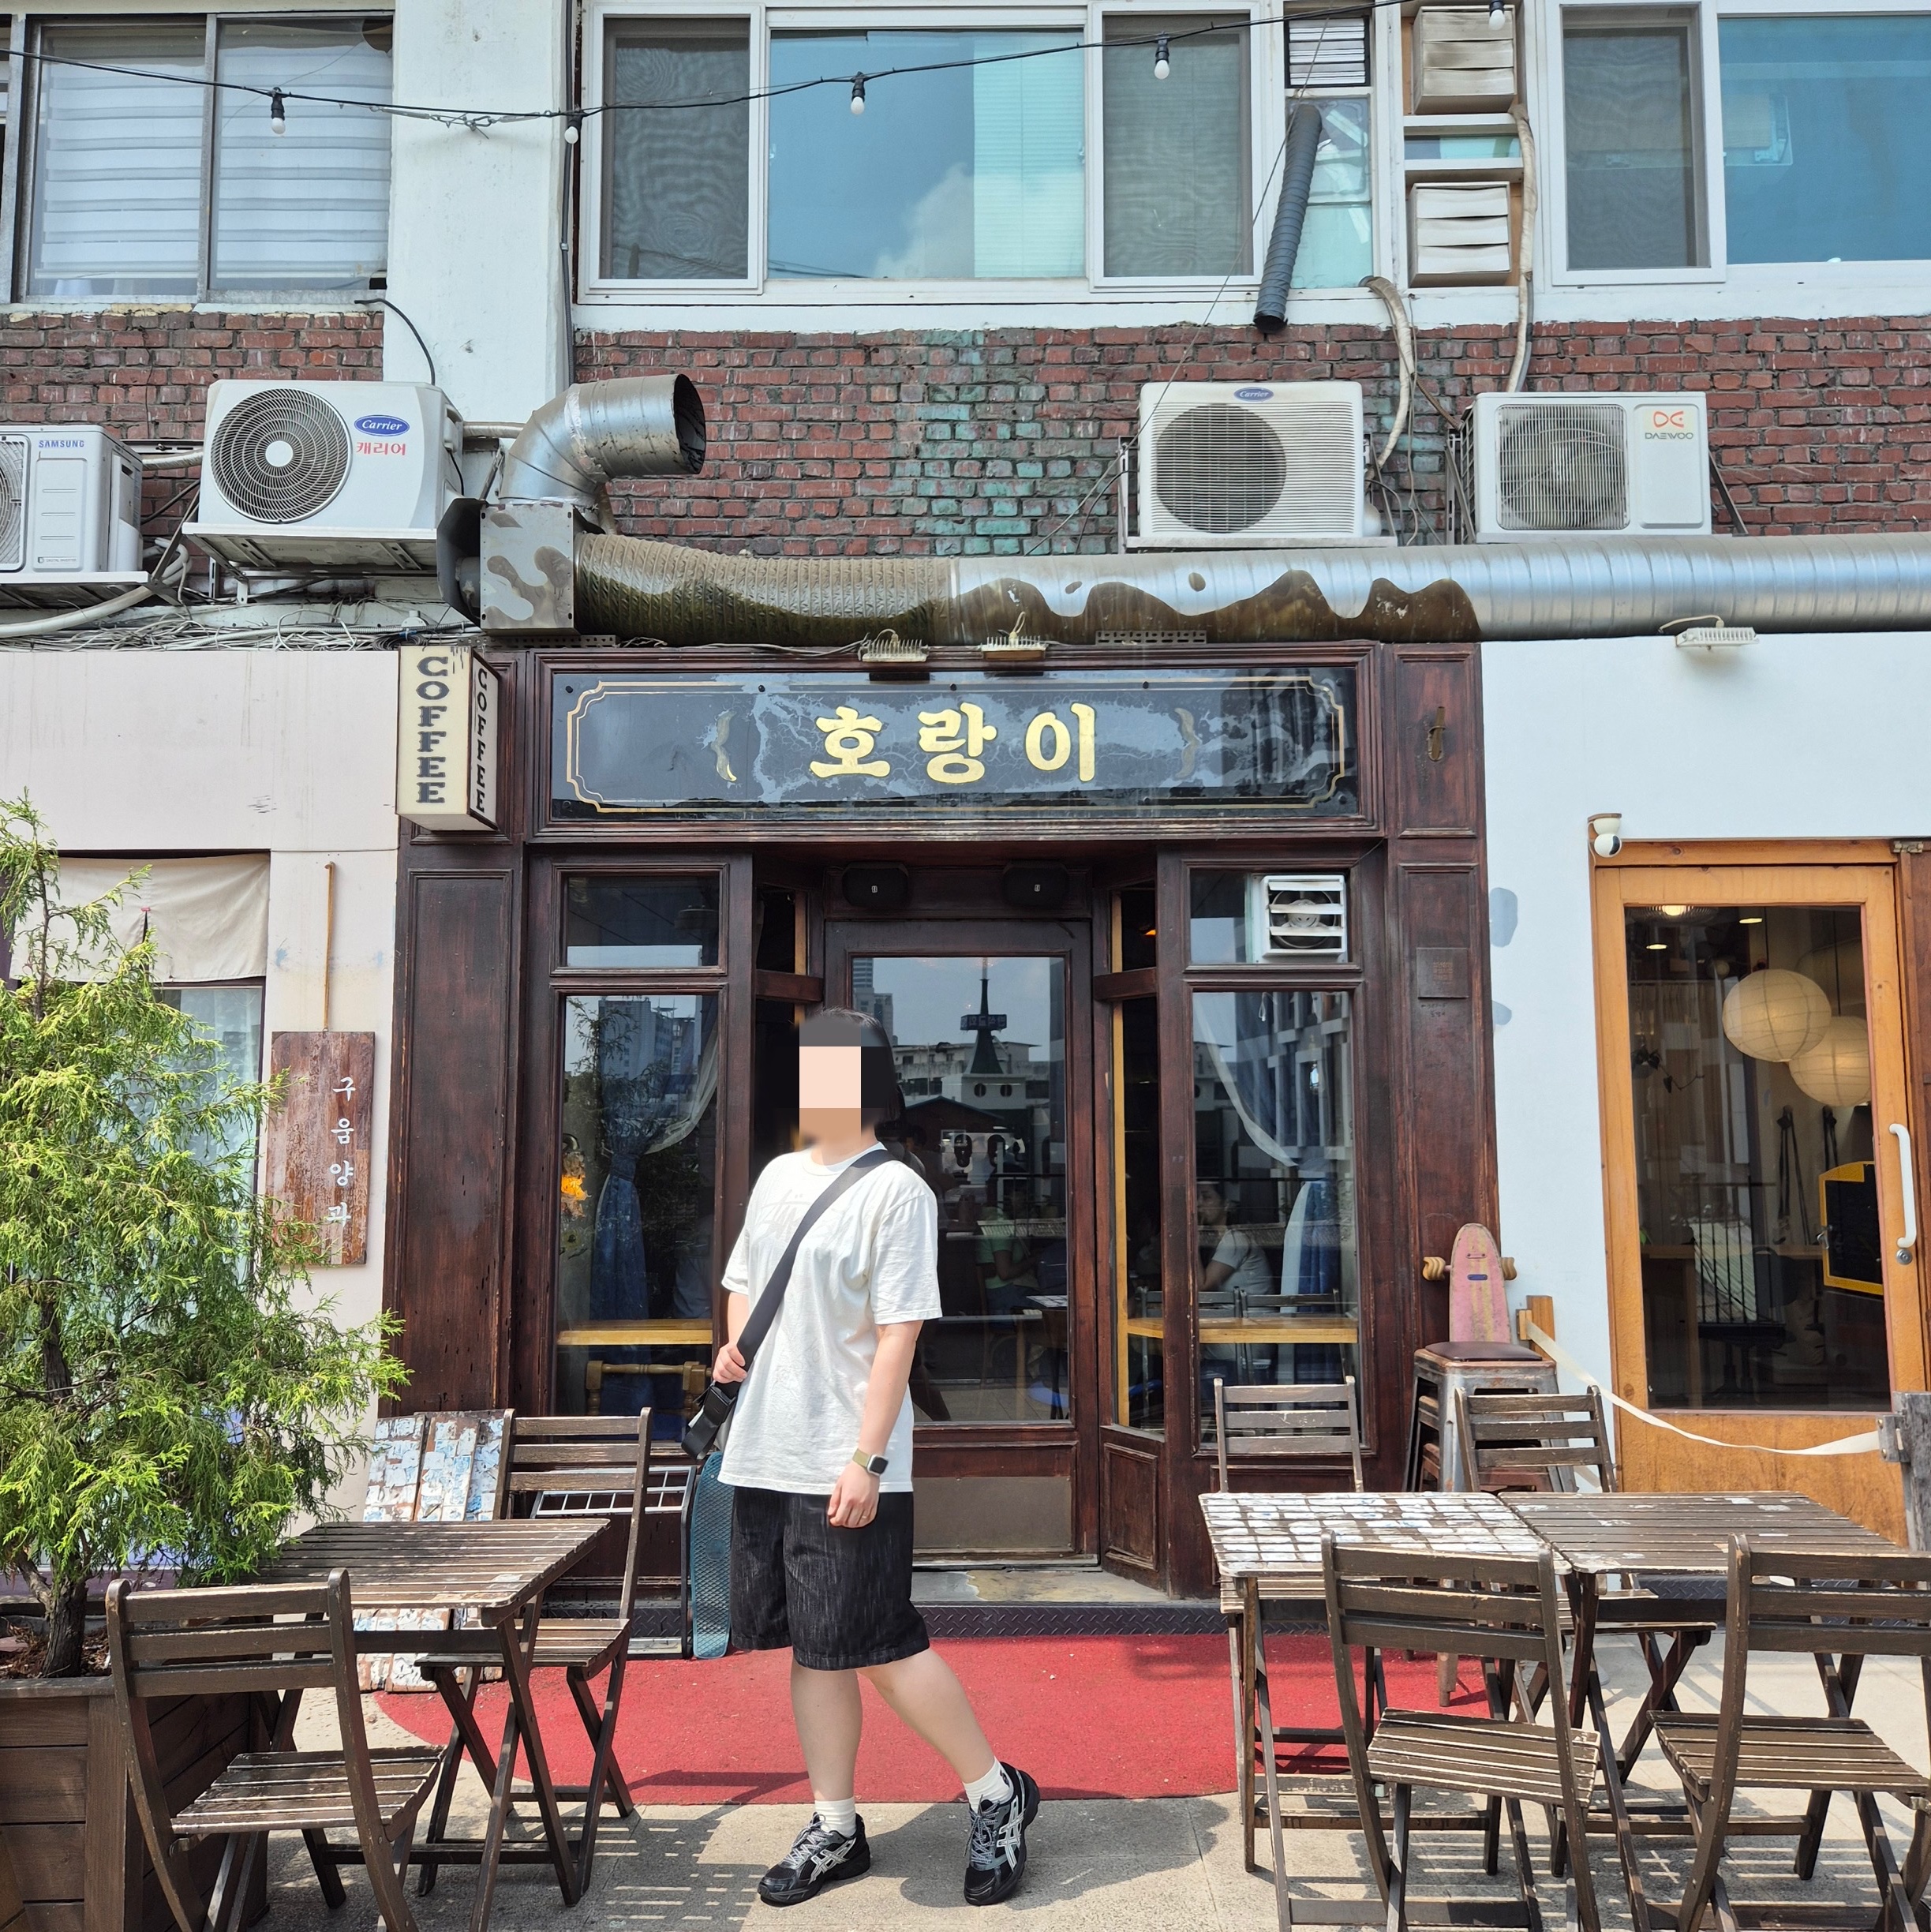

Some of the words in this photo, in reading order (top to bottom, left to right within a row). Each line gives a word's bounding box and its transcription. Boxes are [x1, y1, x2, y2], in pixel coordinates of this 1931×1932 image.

[39, 440, 84, 448] SAMSUNG
[356, 441, 406, 456] 캐리어
[361, 419, 402, 431] Carrier
[415, 656, 450, 803] COFFEE
[476, 668, 488, 813] COFFEE
[810, 702, 1096, 784] 호랑이
[326, 1076, 356, 1229] 구움양과
